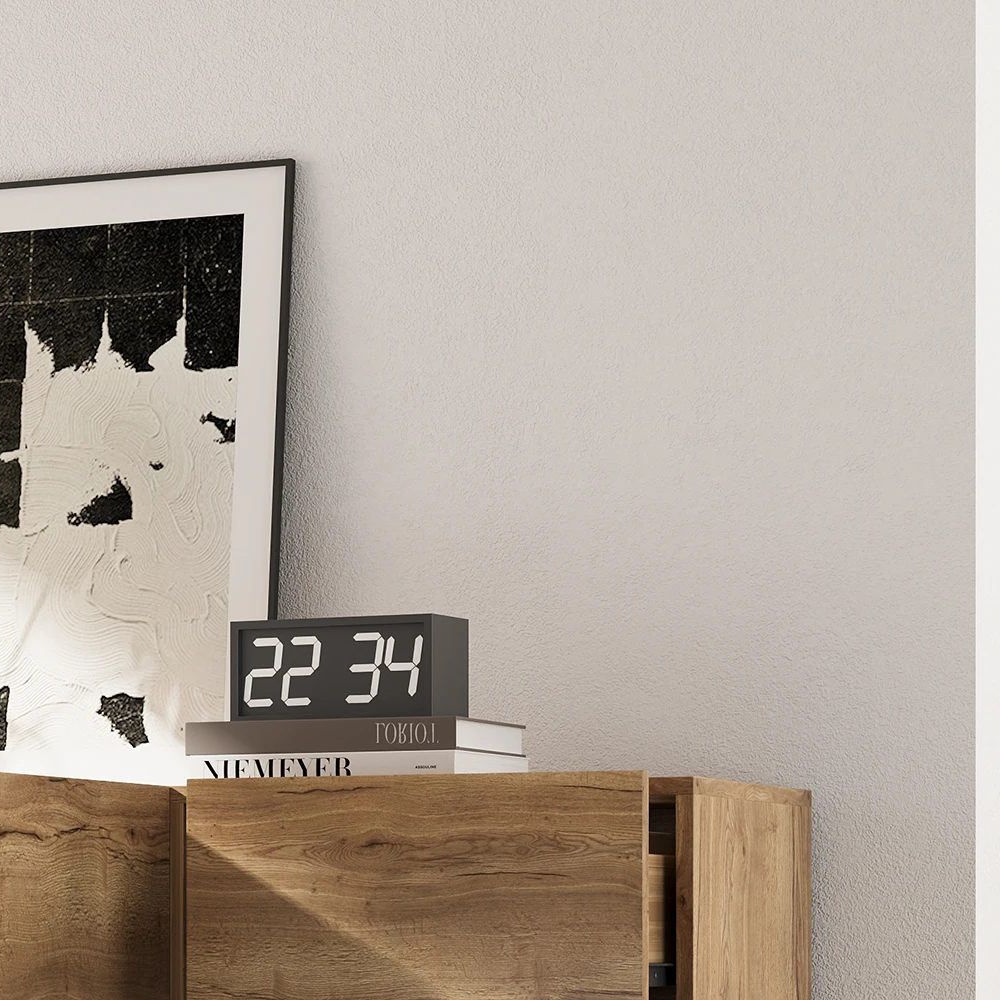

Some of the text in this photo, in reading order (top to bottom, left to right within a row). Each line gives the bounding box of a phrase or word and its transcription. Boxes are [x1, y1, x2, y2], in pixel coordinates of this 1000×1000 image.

[243, 632, 424, 708] 22 34
[203, 756, 351, 779] NIEMEYER
